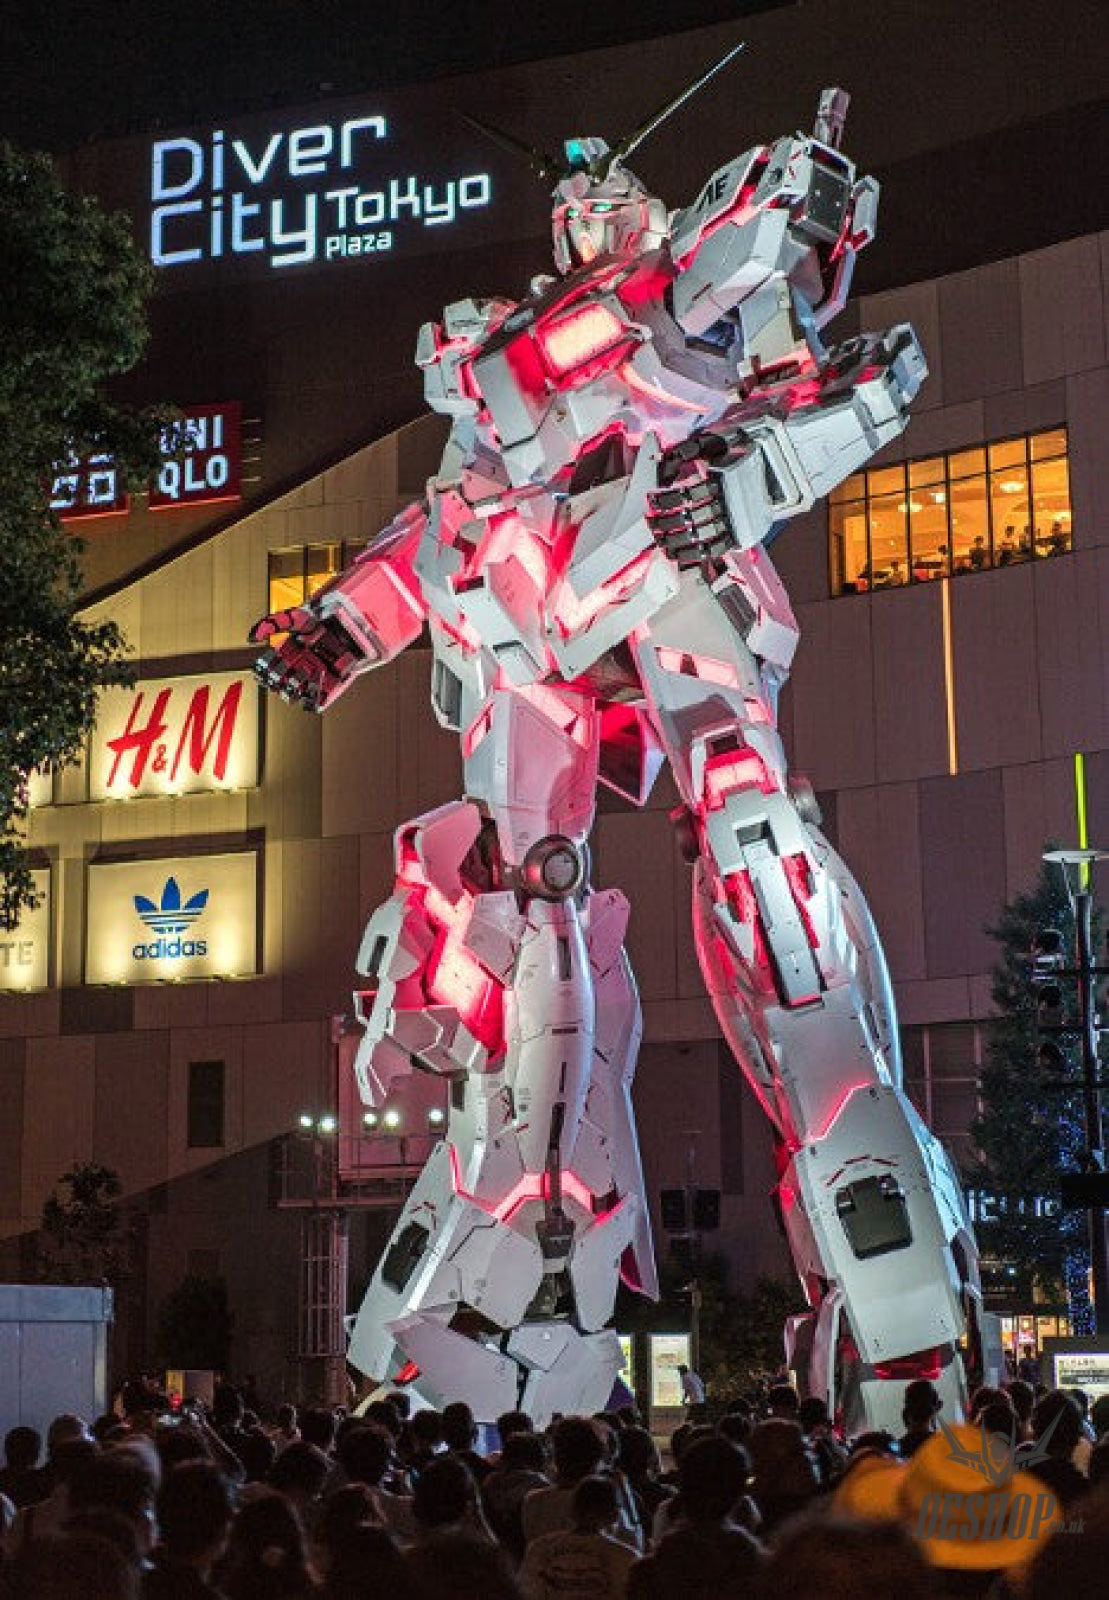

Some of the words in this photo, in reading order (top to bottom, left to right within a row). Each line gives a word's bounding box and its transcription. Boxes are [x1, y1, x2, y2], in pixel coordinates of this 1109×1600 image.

[151, 115, 387, 201] Diver
[151, 192, 318, 268] City
[326, 231, 393, 260] Plaza
[158, 454, 229, 500] QLO
[106, 680, 244, 788] H&M
[132, 936, 208, 961] adidas
